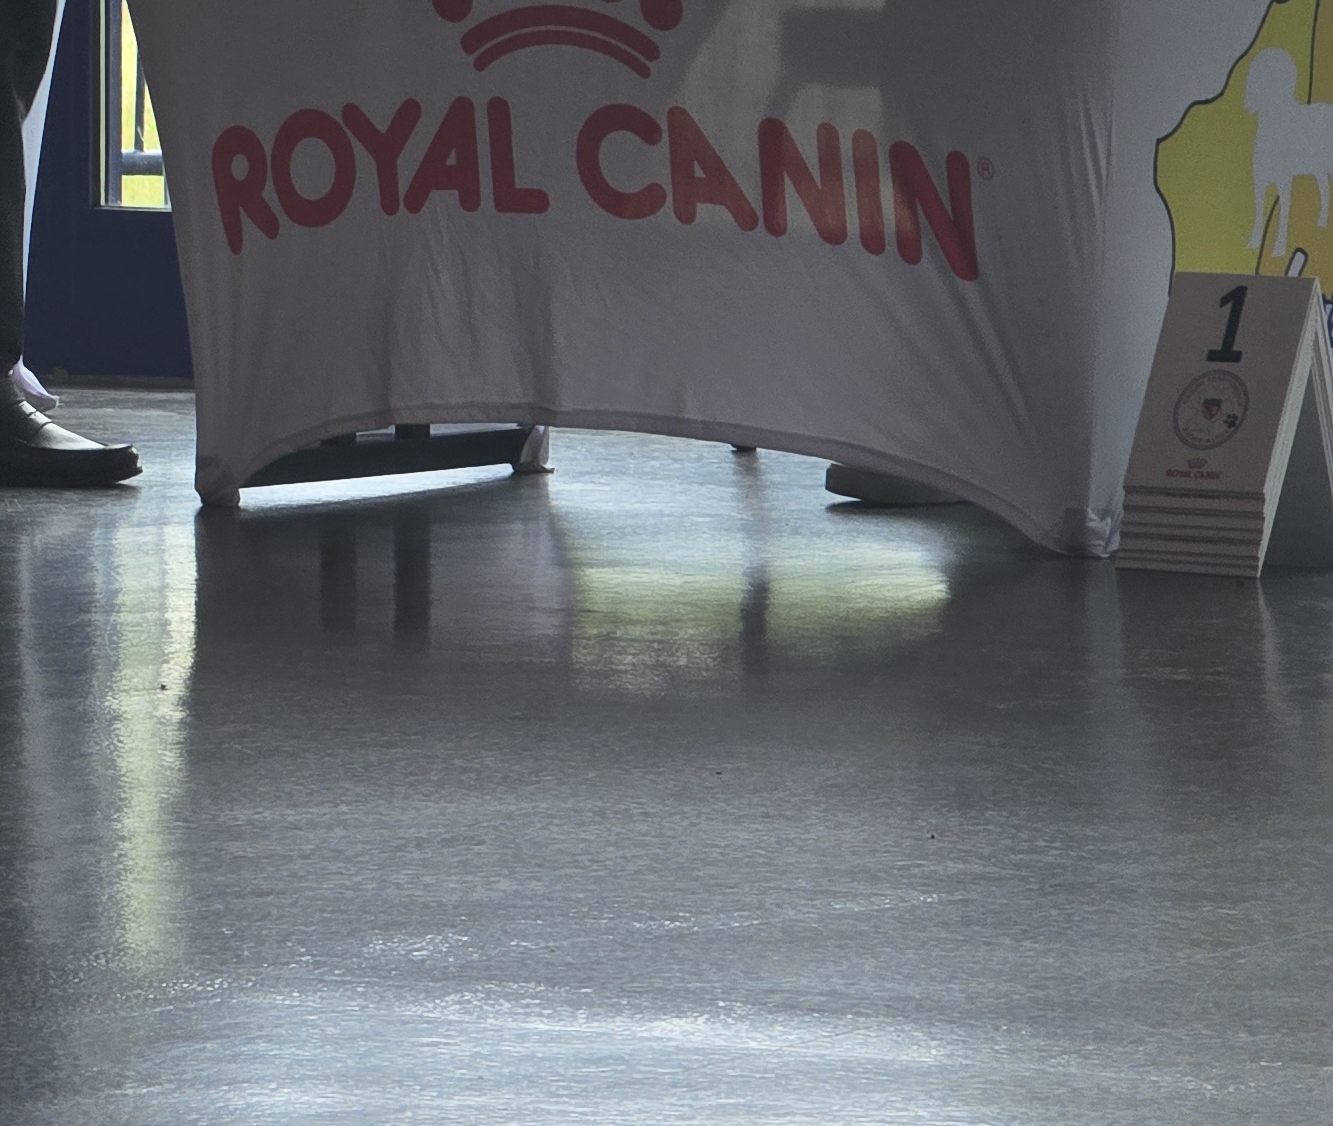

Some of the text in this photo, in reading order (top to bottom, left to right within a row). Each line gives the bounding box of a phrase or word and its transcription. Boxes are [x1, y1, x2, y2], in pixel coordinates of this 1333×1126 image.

[211, 95, 979, 282] ROYAL CANIN
[1205, 285, 1248, 364] 1
